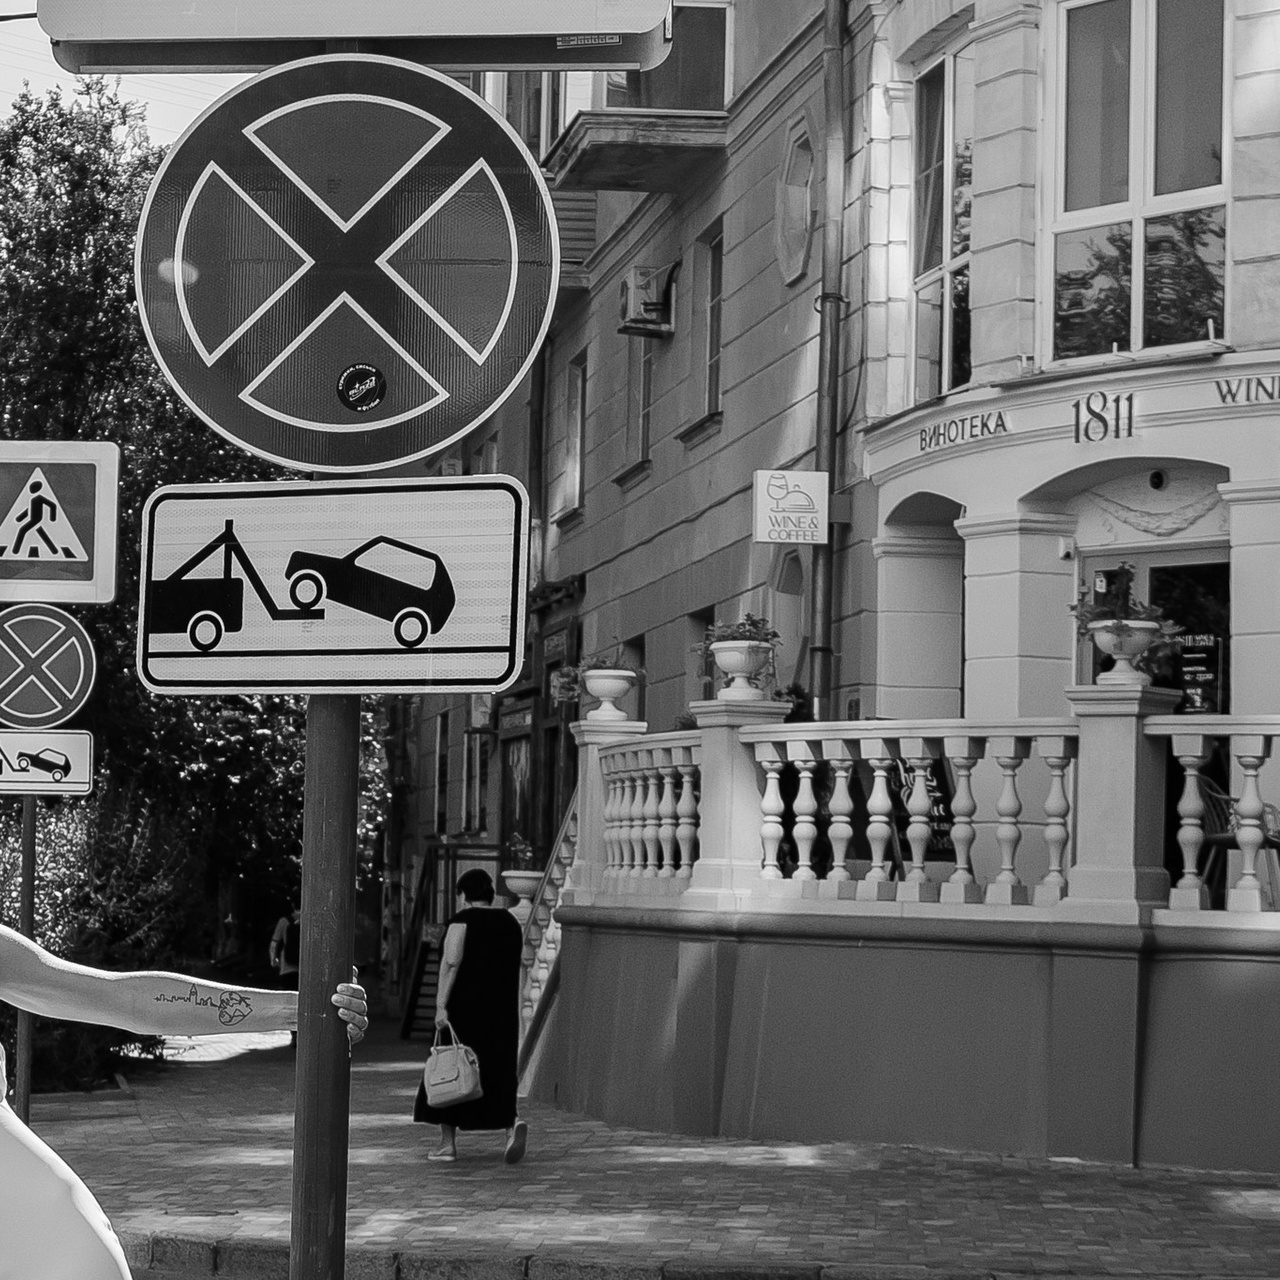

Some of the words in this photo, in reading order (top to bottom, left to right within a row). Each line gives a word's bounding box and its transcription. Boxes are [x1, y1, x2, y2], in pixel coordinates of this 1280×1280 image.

[919, 410, 1008, 452] ВИНОТЕКА
[1071, 390, 1134, 444] 1811
[1214, 376, 1280, 403] WIN
[767, 529, 819, 541] COFFEE
